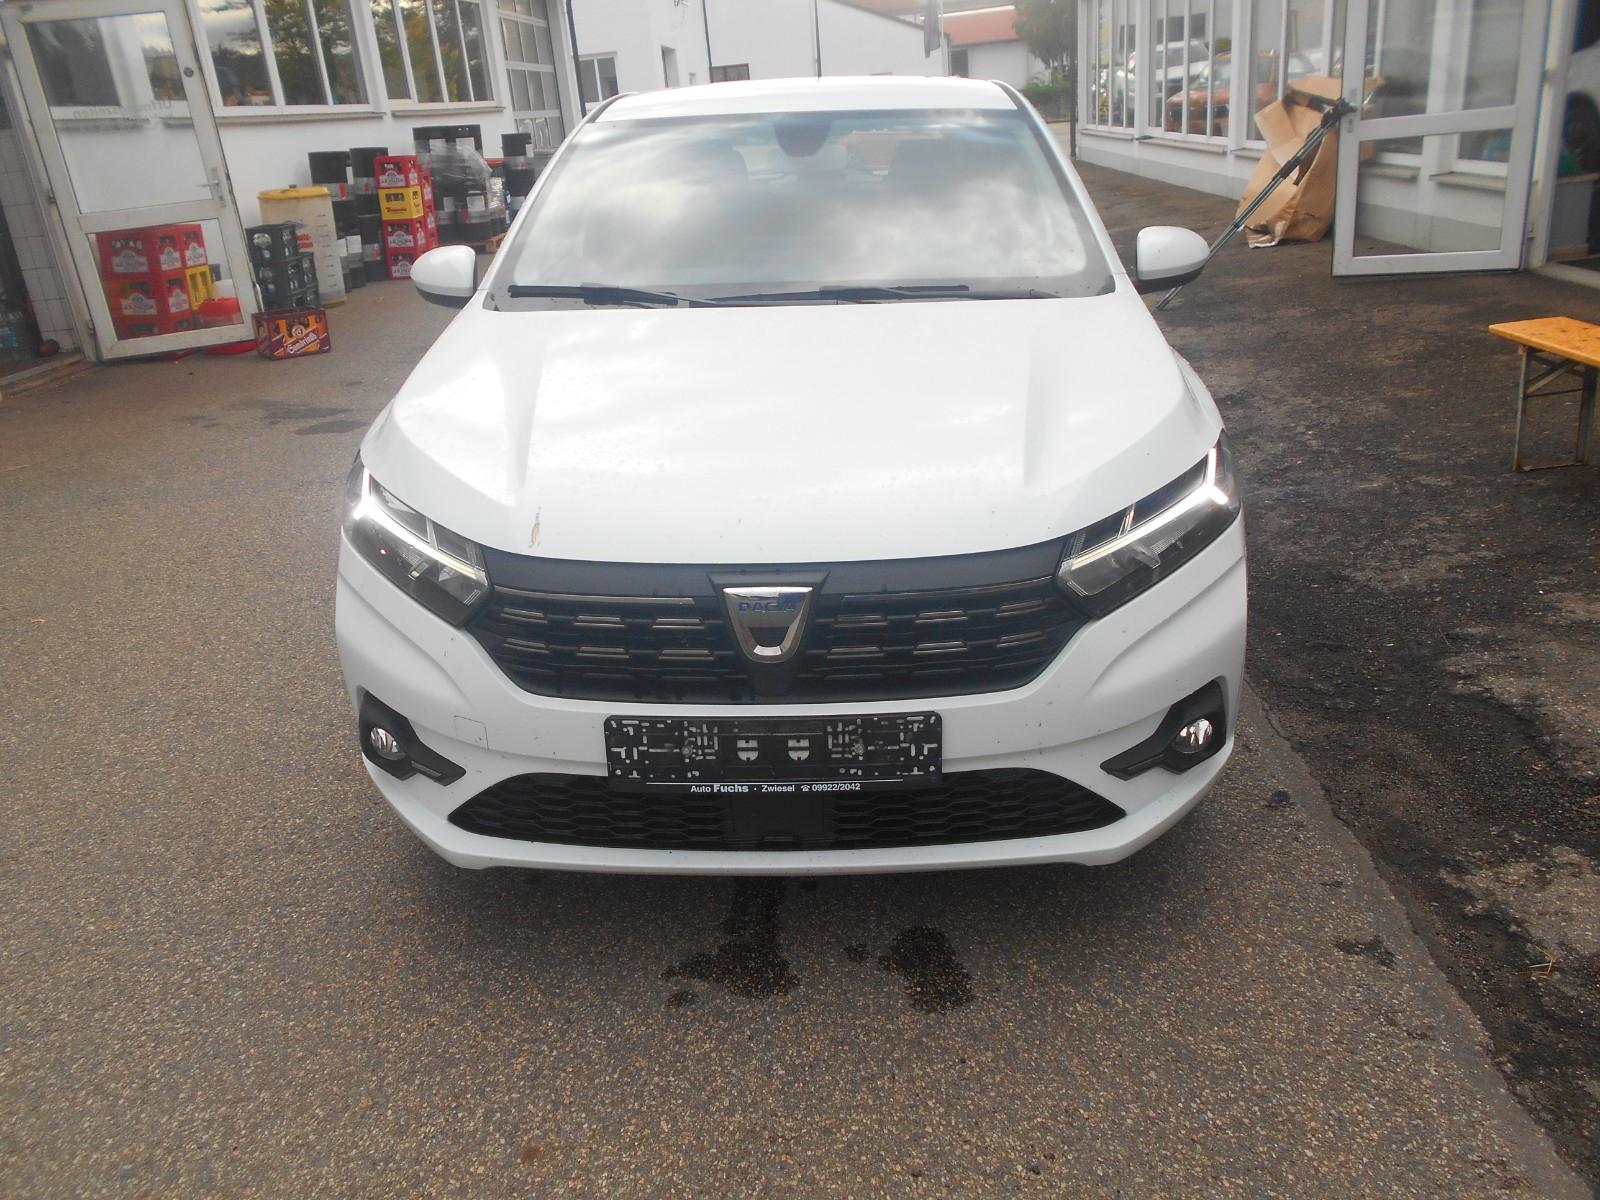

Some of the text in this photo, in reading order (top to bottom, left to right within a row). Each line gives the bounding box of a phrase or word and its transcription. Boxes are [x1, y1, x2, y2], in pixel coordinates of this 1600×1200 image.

[690, 785, 711, 793] Auto
[713, 784, 749, 793] Fuchs
[812, 783, 861, 791] 09922/2042
